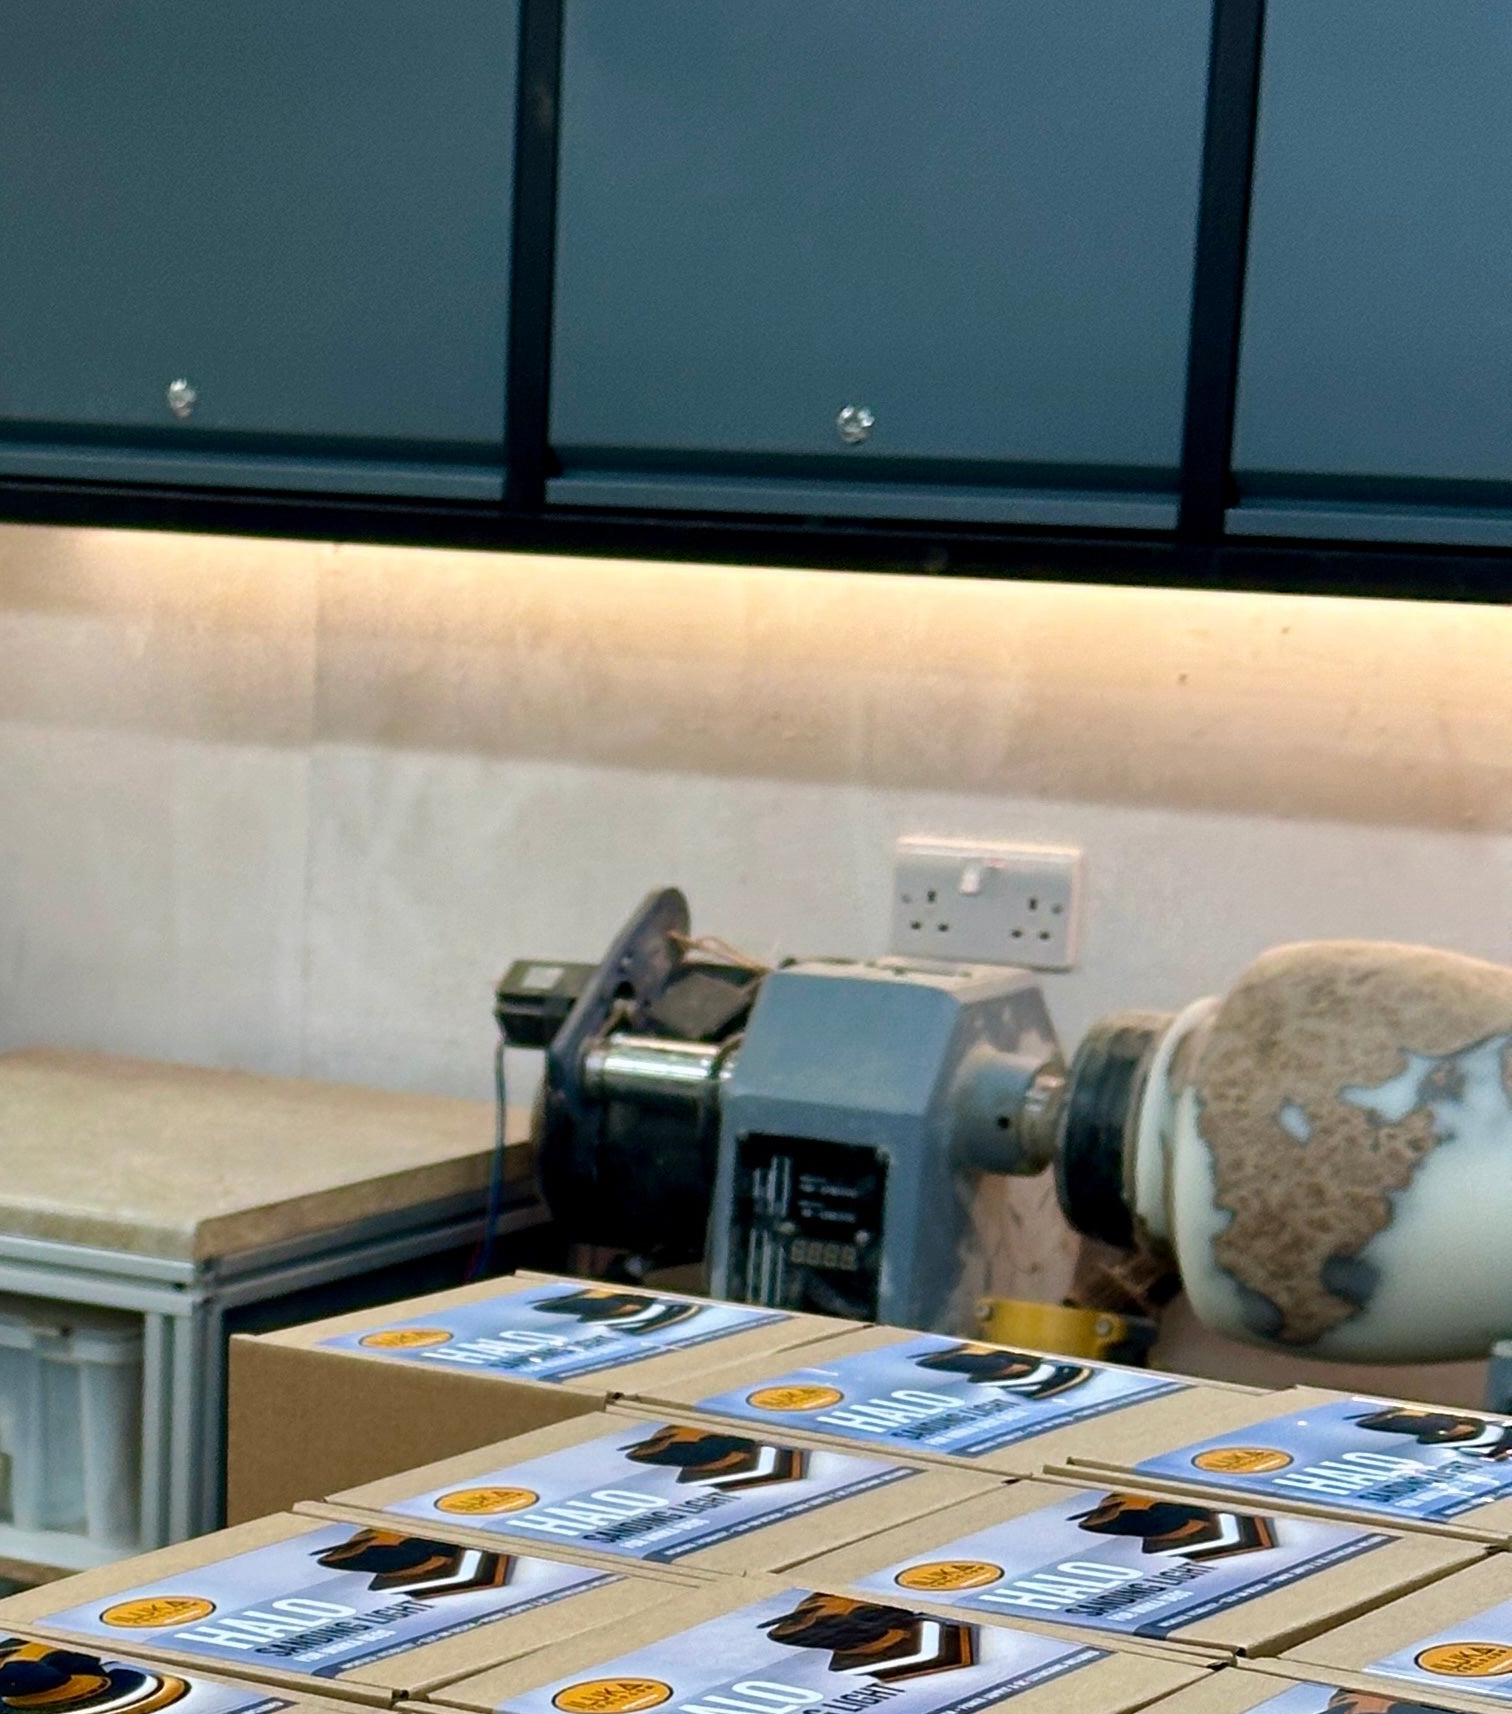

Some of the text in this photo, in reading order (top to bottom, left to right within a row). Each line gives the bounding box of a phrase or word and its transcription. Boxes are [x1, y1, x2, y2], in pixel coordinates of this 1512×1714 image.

[817, 1390, 966, 1433] HALO
[1272, 1452, 1425, 1495] HALO
[506, 1490, 669, 1536] HALO
[979, 1561, 1144, 1610] HALO
[174, 1598, 357, 1650] HALO
[824, 1682, 905, 1714] LIGHT
